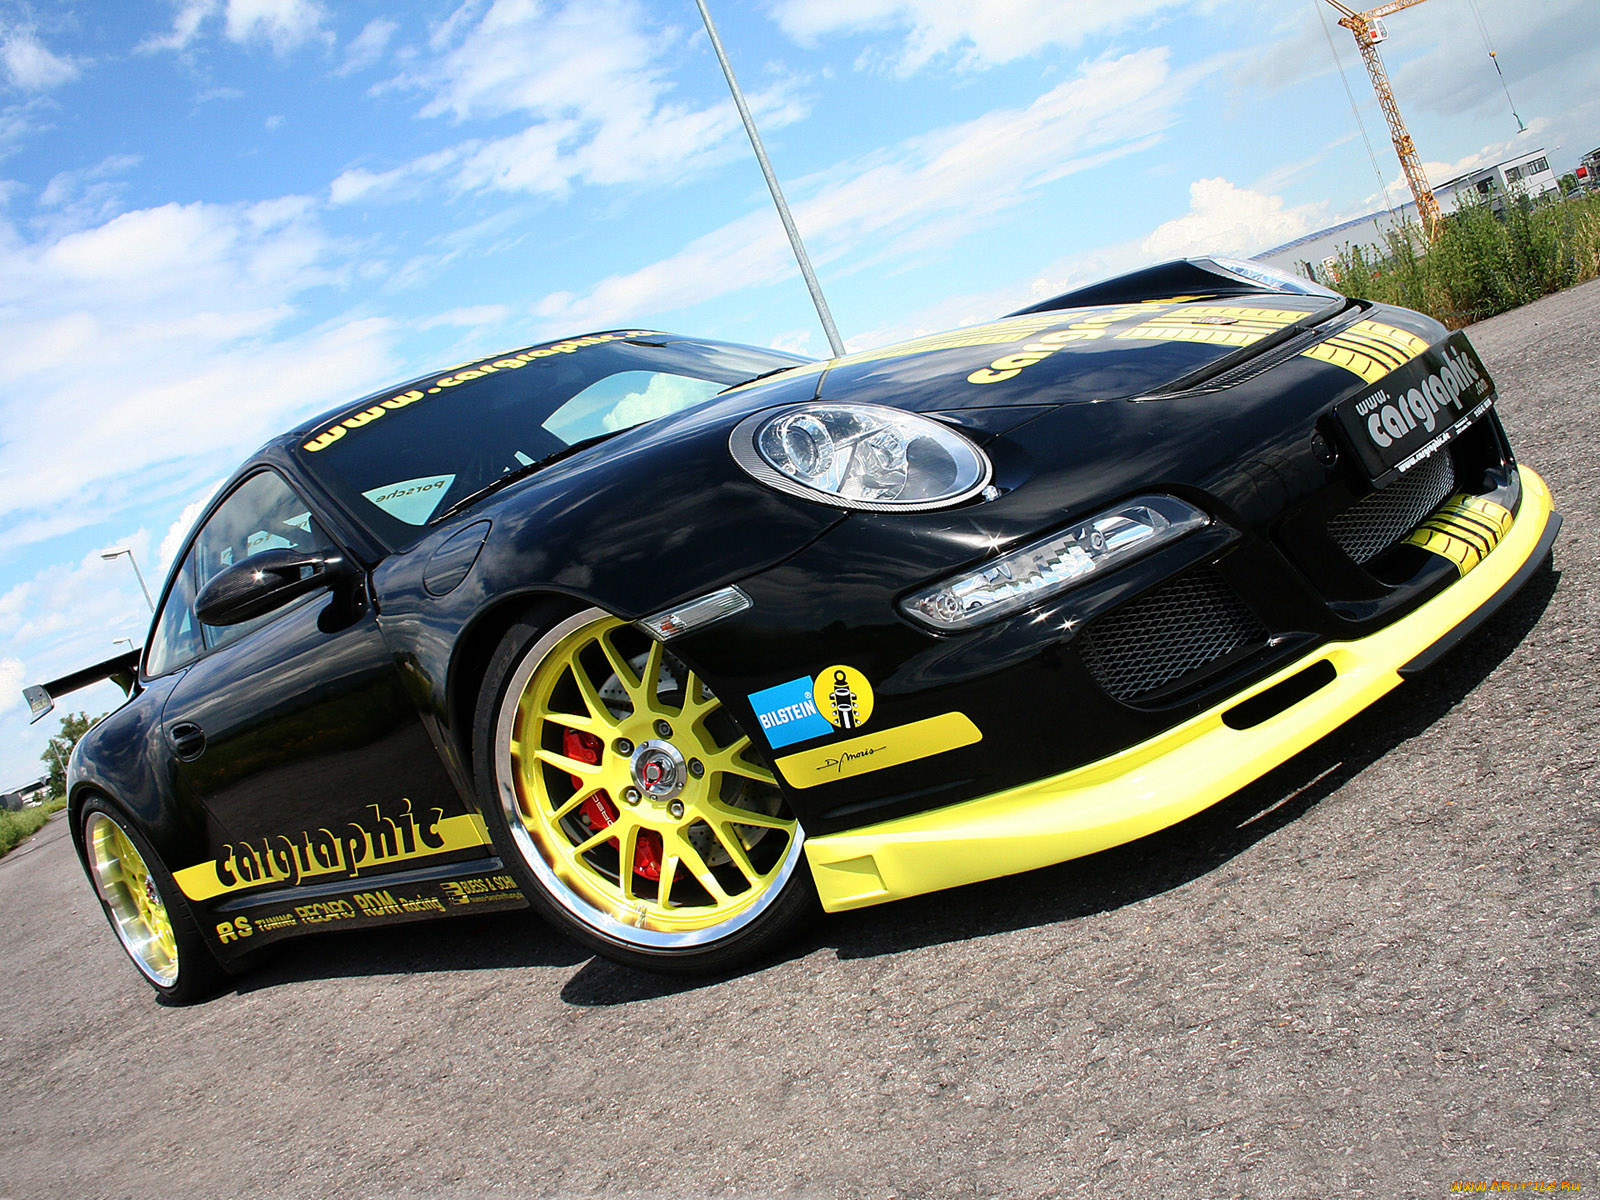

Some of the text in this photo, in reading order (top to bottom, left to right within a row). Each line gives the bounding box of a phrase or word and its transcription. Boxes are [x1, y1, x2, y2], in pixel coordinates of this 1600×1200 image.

[1355, 389, 1391, 416] www.
[1367, 345, 1480, 448] cargraphic
[758, 699, 817, 730] BILSTEIN
[214, 797, 447, 887] cargraphic
[216, 915, 253, 944] RS
[254, 913, 297, 932] TUNING
[294, 899, 356, 924] RECARO
[398, 894, 447, 913] Racing
